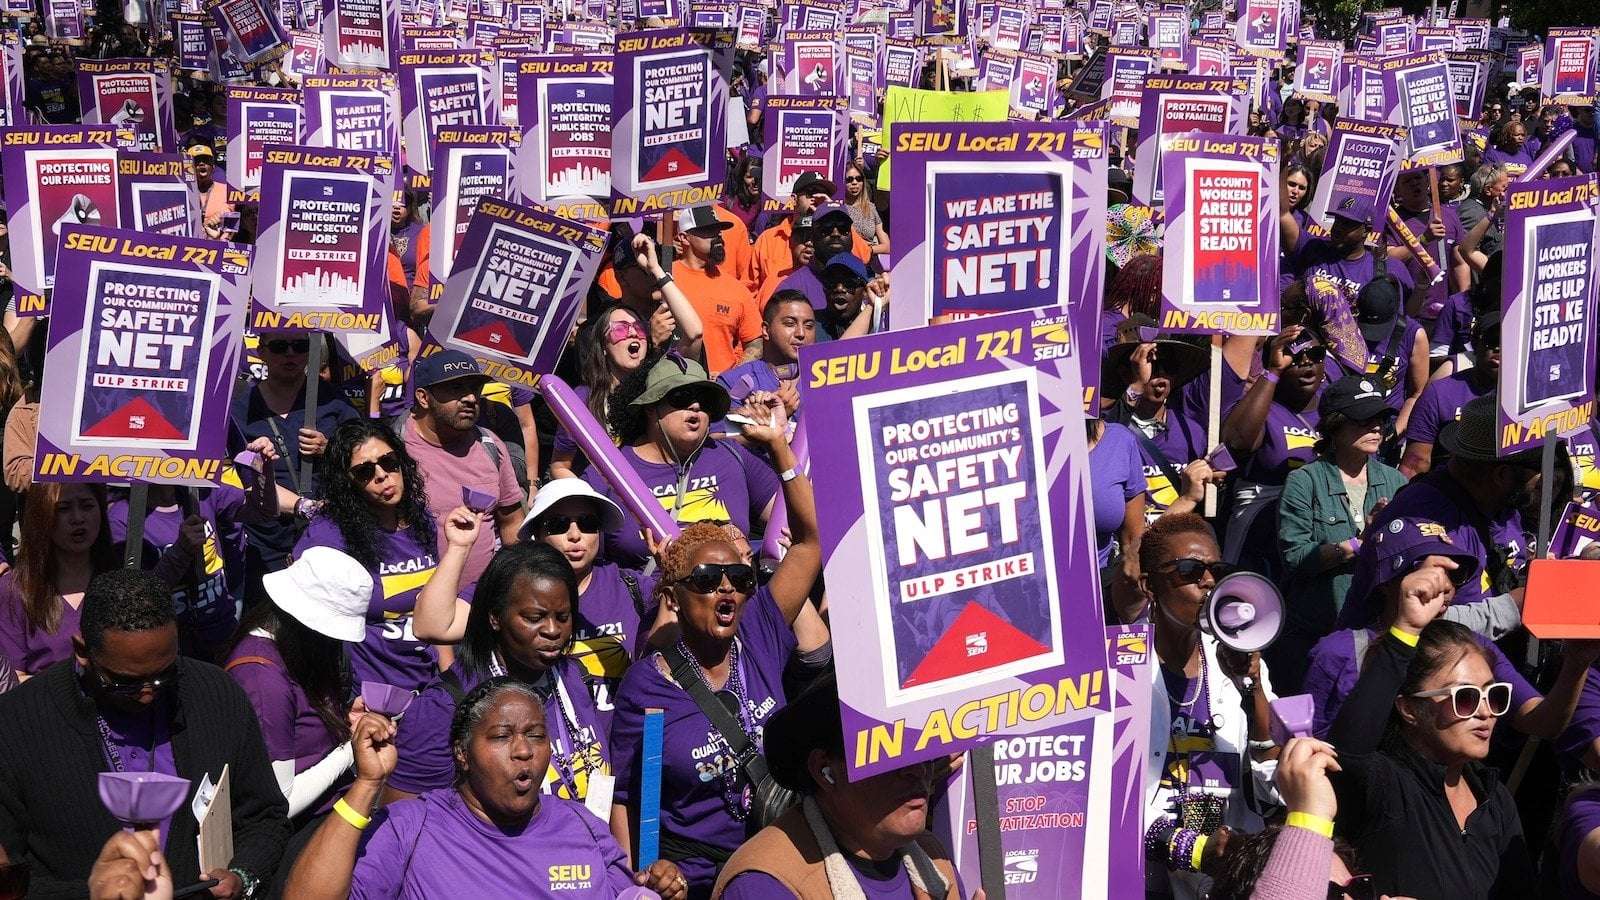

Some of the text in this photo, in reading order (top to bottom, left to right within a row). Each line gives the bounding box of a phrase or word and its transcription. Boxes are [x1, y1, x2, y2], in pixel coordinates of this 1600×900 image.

[618, 33, 711, 53] SEIU Local 721
[786, 32, 802, 40] SEIU
[399, 54, 455, 65] SEIU Local
[520, 61, 614, 74] SEIU Local 721
[1383, 56, 1427, 71] SEIU Local
[645, 63, 703, 79] PROTECTING
[100, 79, 149, 88] PROTECTING
[116, 86, 149, 94] FAMILIES
[1146, 79, 1207, 90] SEIU Local
[1410, 83, 1445, 97] WORKERS
[645, 82, 703, 103] SAFETY
[1411, 92, 1446, 106] ARE ULP
[429, 93, 476, 113] SAFETY
[551, 102, 611, 113] PROTECTING
[768, 99, 815, 107] SEIU Local
[1166, 103, 1224, 113] PROTECTING
[336, 116, 381, 130] SAFETY
[645, 102, 703, 132] NET
[1187, 113, 1223, 122] FAMILIES
[1413, 111, 1449, 127] READY!
[5, 132, 82, 145] SEIU Local
[336, 132, 382, 149] NET!
[897, 133, 1101, 159] SEIU Local 721 SEIU
[1165, 139, 1259, 155] SEIU Local 721
[266, 150, 370, 169] SEIU Local 721
[1342, 156, 1383, 168] PROTECT
[1415, 149, 1463, 167] ACTION!
[40, 163, 110, 174] PROTECTING
[1339, 165, 1381, 179] OUR JOBS
[62, 175, 111, 185] FAMILIES
[1200, 177, 1252, 188] LA COUNTY
[613, 183, 724, 214] IN ACTION!
[1200, 190, 1253, 201] WORKERS
[1510, 185, 1588, 210] SEIU Local 721
[292, 199, 361, 213] PROTECTING
[946, 192, 1054, 218] WE ARE THE
[1200, 203, 1252, 217] ARE ULP
[302, 212, 350, 223] INTEGRITY
[479, 203, 554, 233] SEIU Local
[1200, 218, 1252, 233] STRIKE
[310, 233, 338, 245] JOBS
[946, 216, 1053, 251] SAFETY
[495, 238, 563, 266] PROTECTING
[1200, 236, 1252, 251] READY!
[64, 232, 247, 275] SEIU Local 721 SEIU
[1539, 242, 1588, 263] LA COUNTY
[487, 256, 557, 286] SAFETY
[947, 249, 1052, 298] NET!
[1537, 260, 1587, 281] WORKERS
[104, 281, 201, 302] PROTECTING
[478, 273, 551, 309] NET
[1535, 278, 1585, 303] ARE ULP
[103, 297, 198, 313] OUR COMMUNITY'S
[100, 309, 197, 334] SAFETY
[254, 311, 381, 330] IN ACTION!
[1163, 311, 1277, 330] IN ACTION!
[1533, 323, 1583, 351] READY!
[96, 330, 194, 371] NET
[809, 318, 1055, 389] SEIU Local 721 LOCAL
[1033, 344, 1069, 361] SEIU
[97, 374, 185, 390] ULP STRIKE
[883, 403, 1019, 447] PROTECTING
[1502, 400, 1593, 449] IN ACTION!
[885, 428, 1020, 465] OUR COMMUNITY'S
[1575, 443, 1594, 455] 721
[40, 453, 221, 480] IN ACTION!
[888, 446, 1023, 502] SAFETY
[692, 475, 717, 492] 721
[893, 481, 1027, 566] NET
[380, 557, 425, 574] LOCAL
[906, 558, 1029, 598] ULP STRIKE
[597, 622, 623, 635] 721
[1116, 654, 1146, 665] SEIU
[854, 670, 1104, 769] IN ACTION!
[994, 735, 1086, 760] ROTECT
[995, 760, 1086, 786] UR JOBS
[1006, 797, 1046, 812] STOP
[967, 813, 1083, 835] PATIZATION
[549, 865, 591, 881] SEIU
[1004, 872, 1037, 884] SEIU
[551, 883, 576, 891] LOCAL
